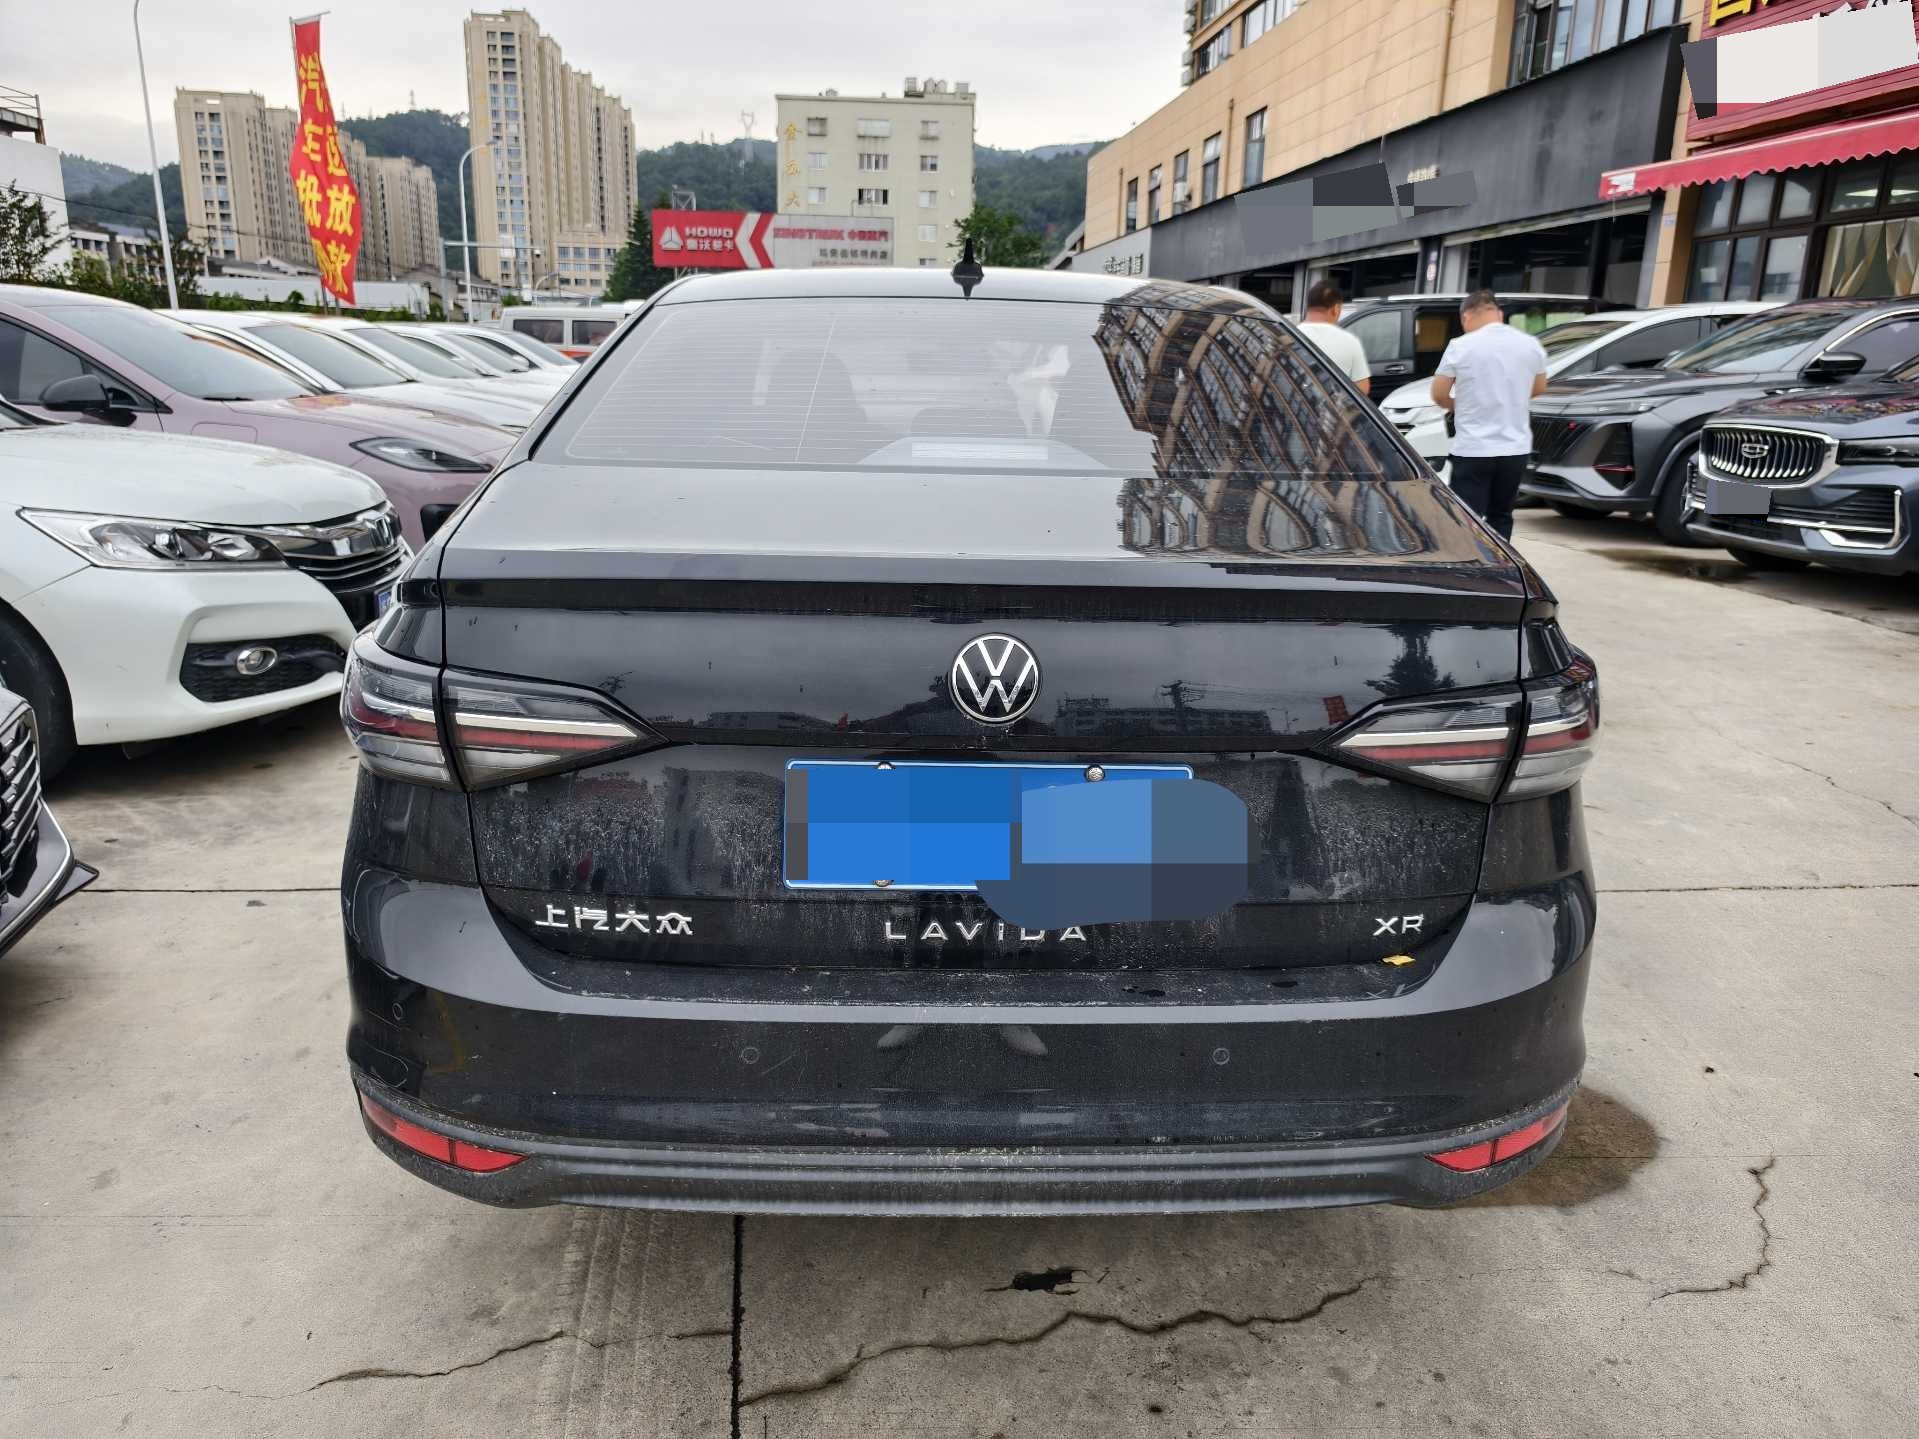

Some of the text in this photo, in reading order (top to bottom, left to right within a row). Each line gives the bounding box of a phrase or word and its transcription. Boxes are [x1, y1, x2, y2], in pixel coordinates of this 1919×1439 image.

[686, 239, 734, 252] 沃卡
[535, 904, 694, 936] 上汽大众
[1372, 913, 1425, 936] XR
